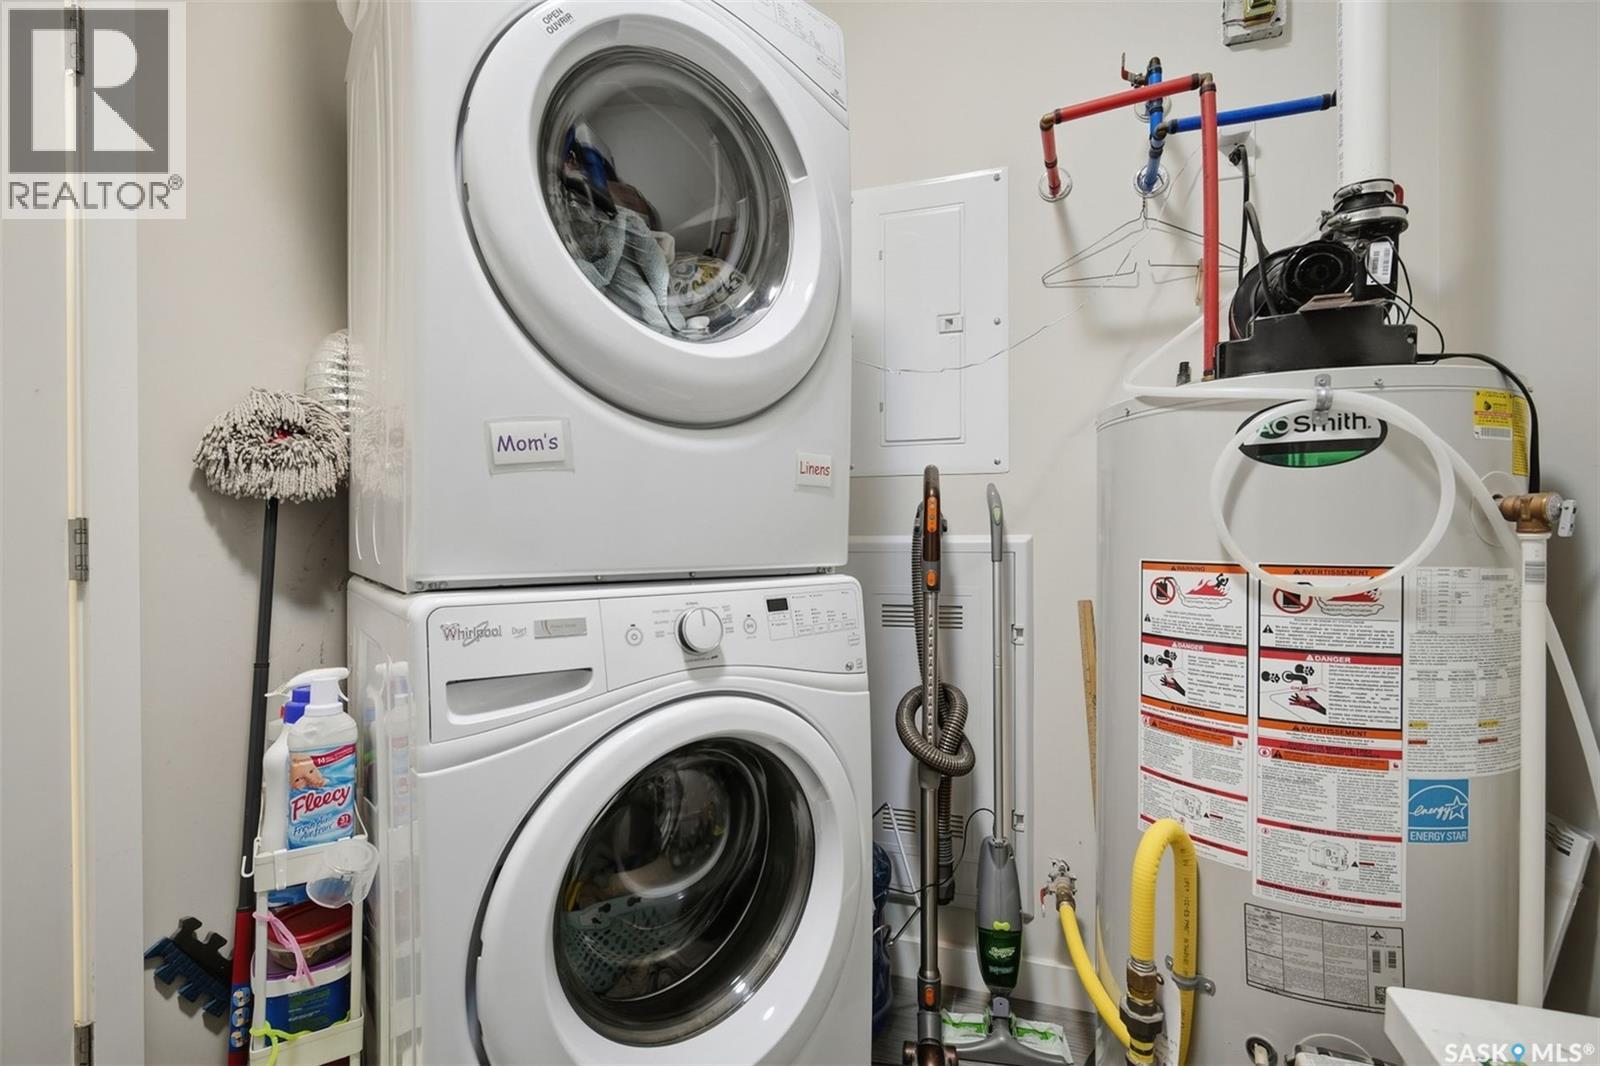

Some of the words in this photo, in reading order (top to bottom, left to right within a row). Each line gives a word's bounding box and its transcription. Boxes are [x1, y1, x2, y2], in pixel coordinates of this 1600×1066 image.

[542, 7, 564, 25] OPEN
[546, 12, 574, 35] OUVRIR
[497, 432, 559, 452] Mom's
[799, 460, 831, 477] Linens
[1299, 568, 1369, 576] AVERTISSEMENT
[440, 621, 503, 645] Whirlpool
[1314, 655, 1352, 664] DANGER
[1301, 725, 1368, 737] AVERTISSEMENT
[290, 785, 351, 821] Fleecy
[1409, 830, 1446, 841] ENERGY
[1446, 830, 1467, 841] STAR
